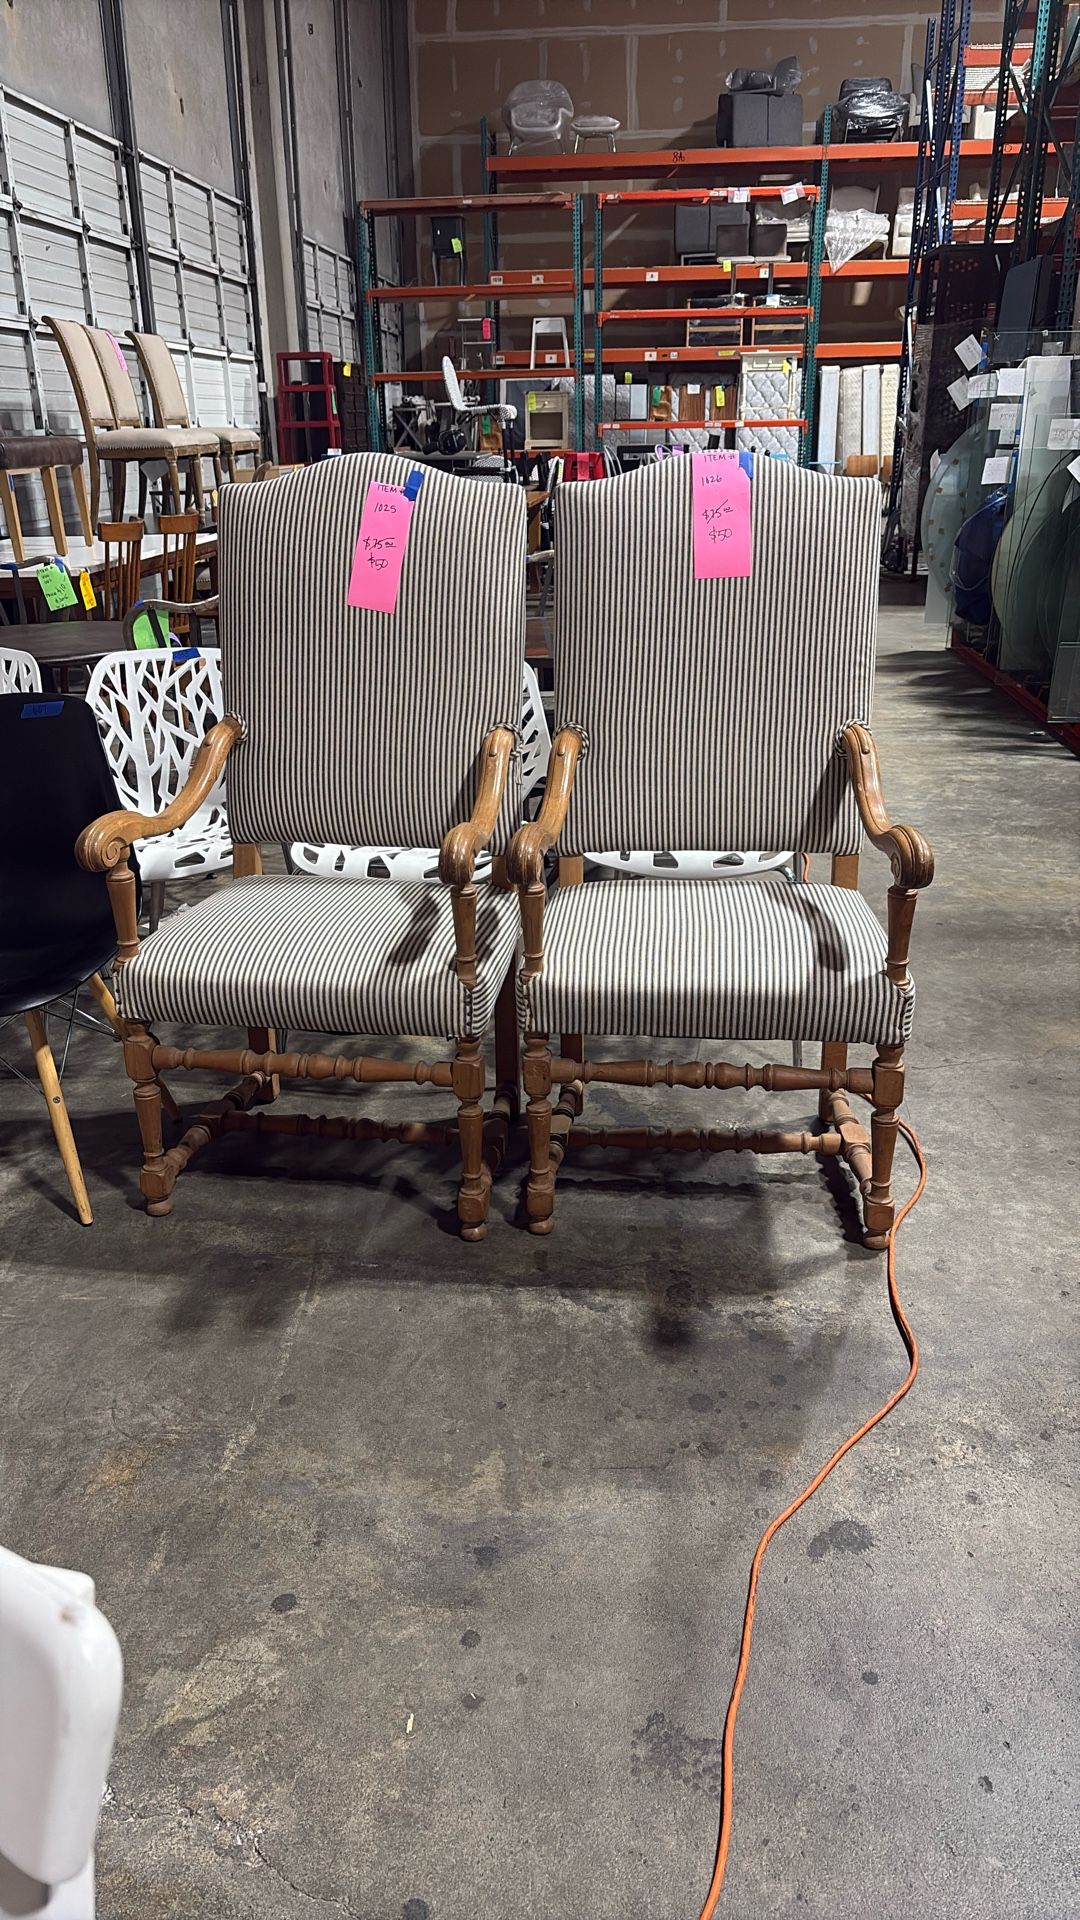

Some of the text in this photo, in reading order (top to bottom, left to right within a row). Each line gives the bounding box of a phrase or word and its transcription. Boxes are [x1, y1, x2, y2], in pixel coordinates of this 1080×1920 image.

[704, 454, 726, 463] ITEM
[377, 484, 397, 494] ITEM
[708, 526, 733, 543] $50
[367, 552, 389, 571] $50
